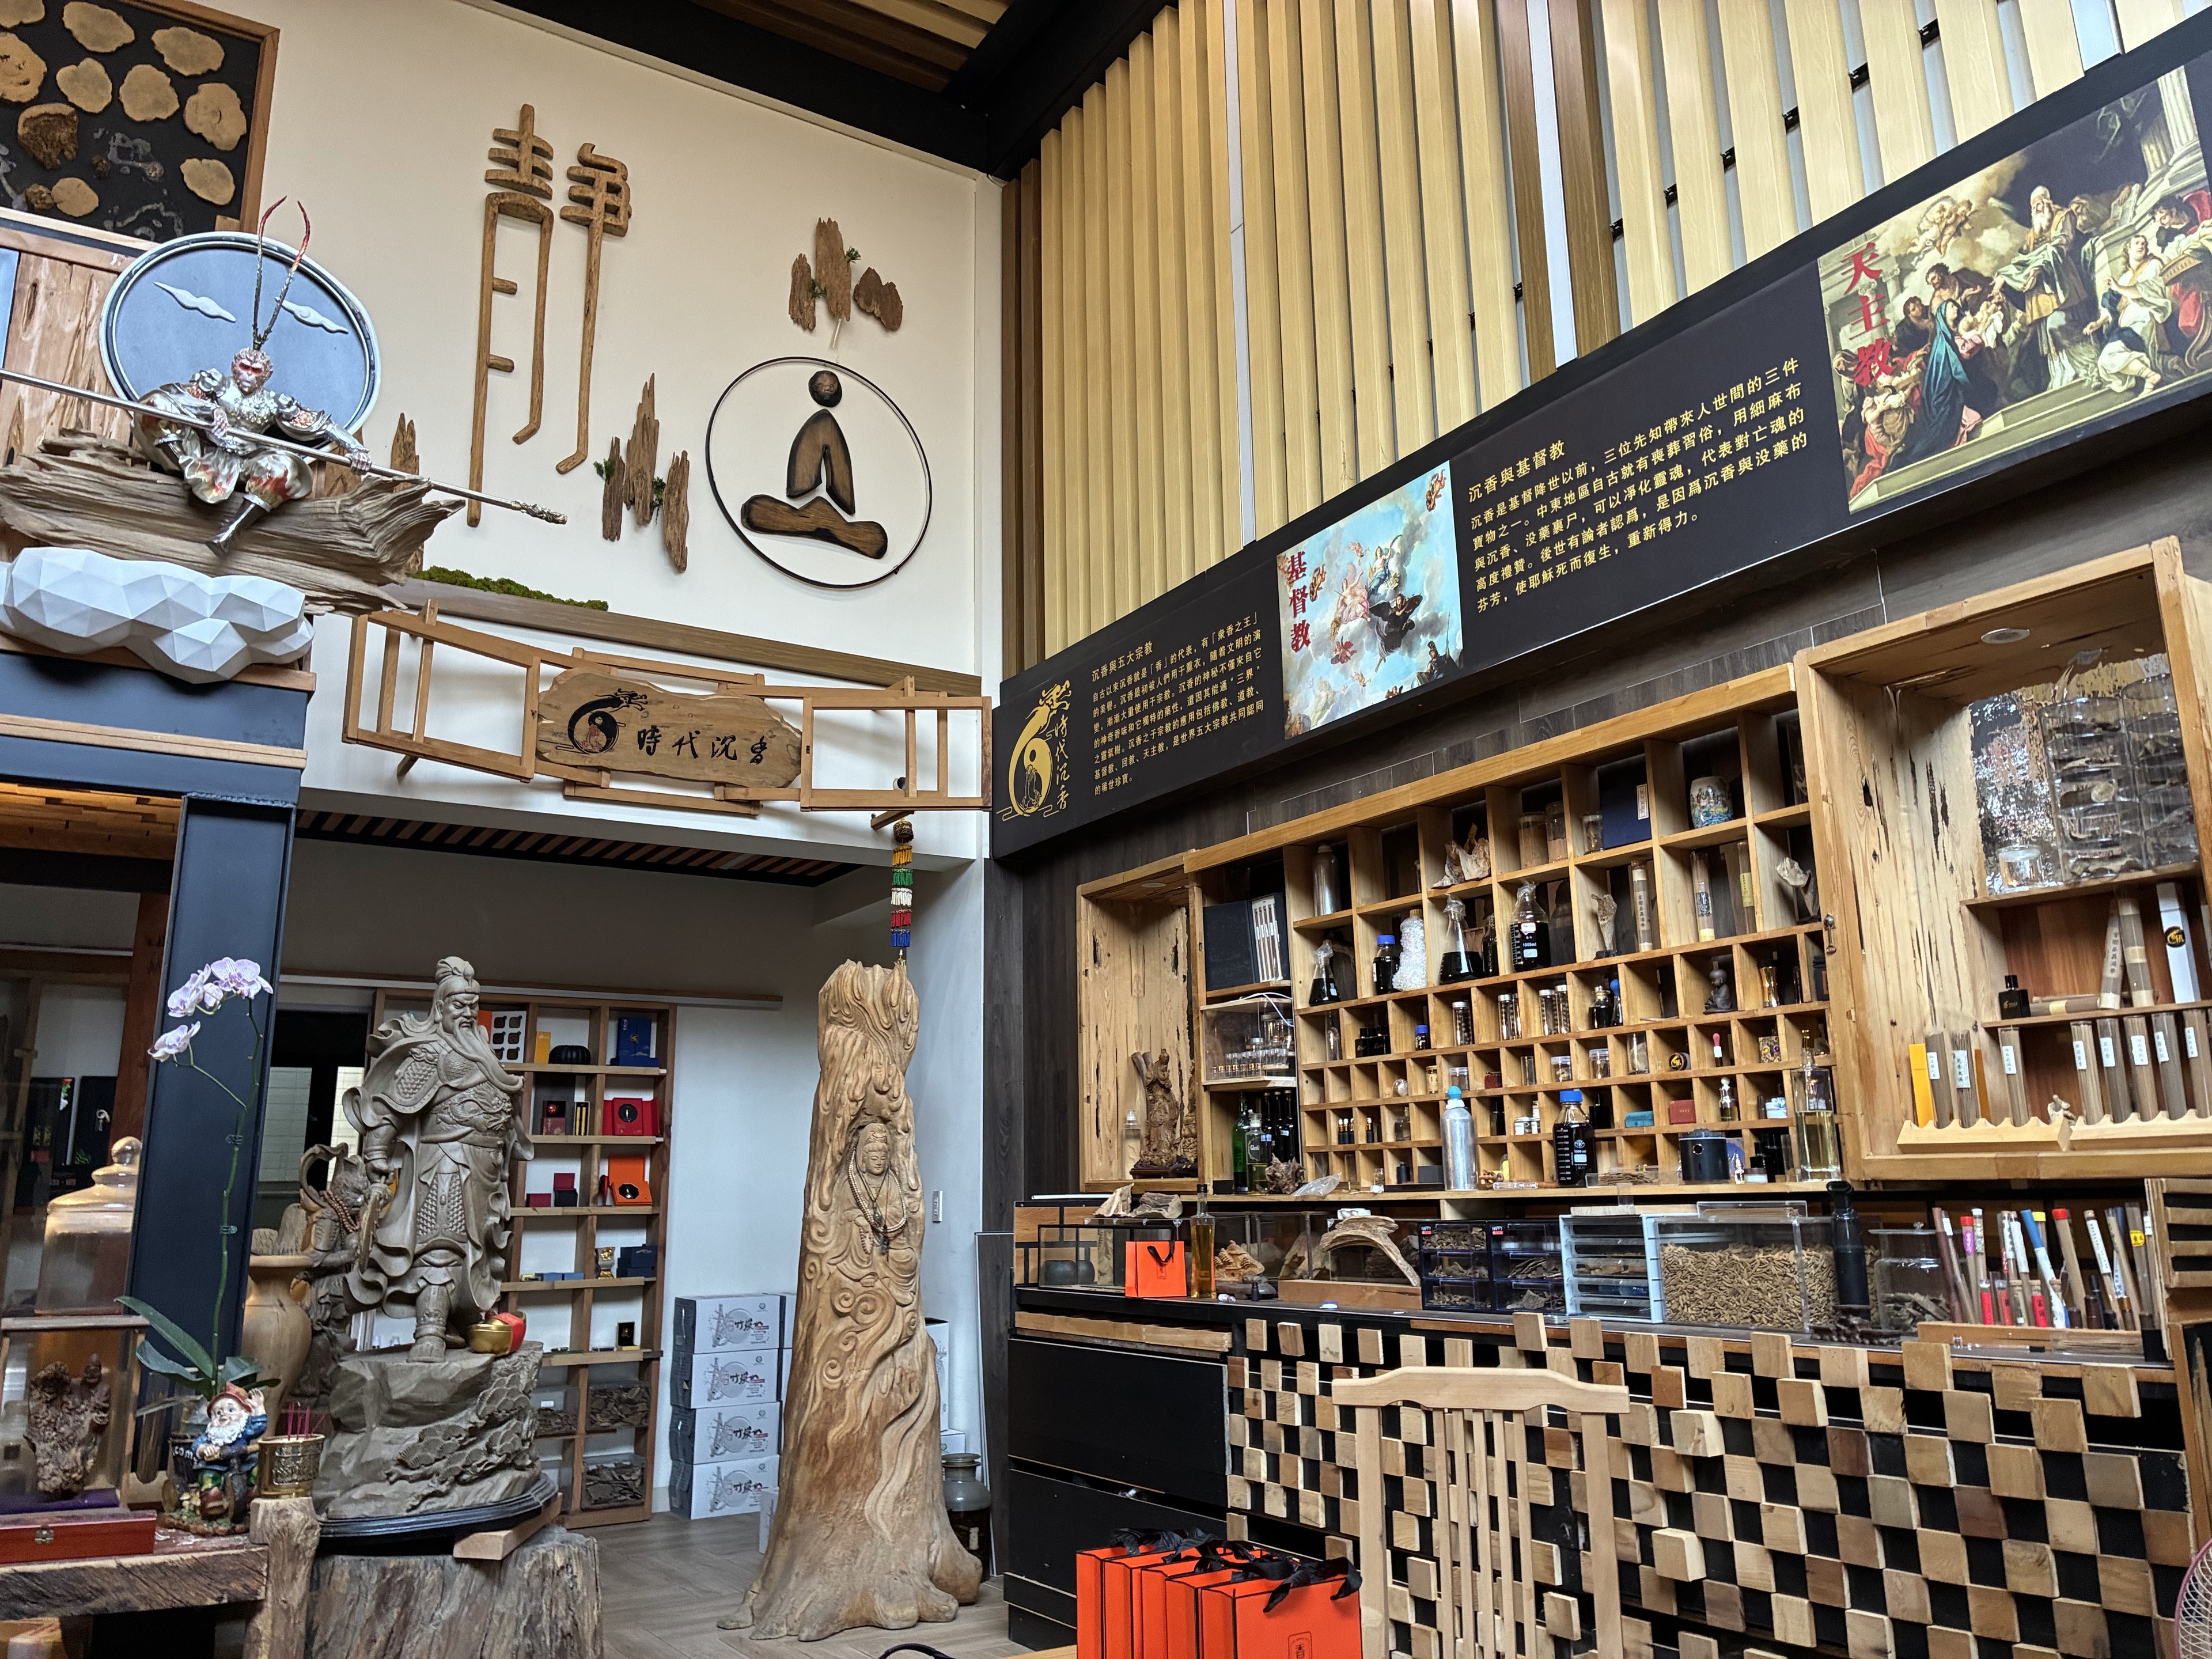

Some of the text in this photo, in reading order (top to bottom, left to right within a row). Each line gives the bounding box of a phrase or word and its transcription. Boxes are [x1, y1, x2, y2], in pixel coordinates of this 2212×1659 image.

[1841, 242, 1895, 387] 天主教
[1469, 440, 1565, 502] 沉香與基督教
[1289, 551, 1311, 653] 基督教
[1092, 641, 1153, 683] 沉香與五大宗教
